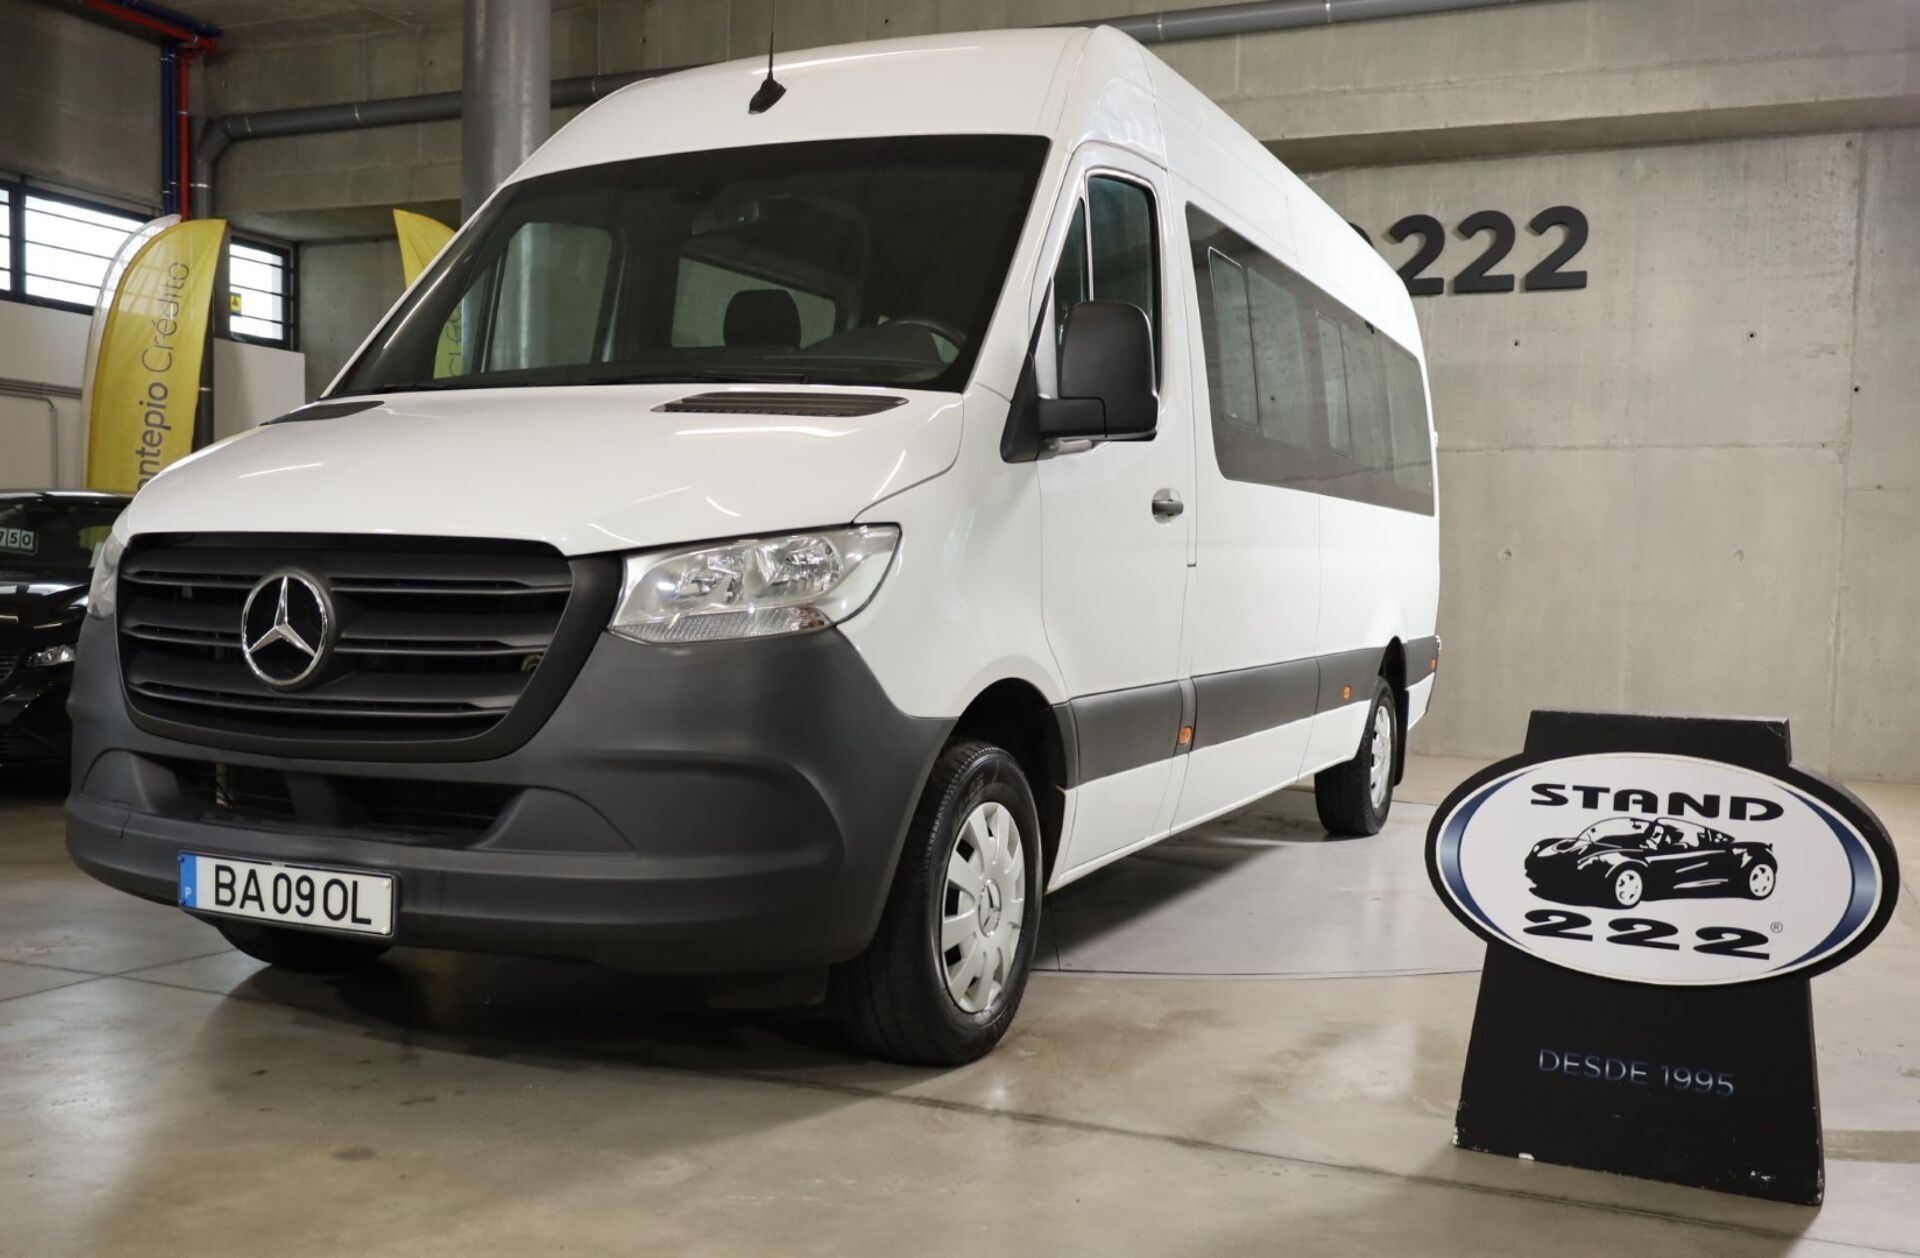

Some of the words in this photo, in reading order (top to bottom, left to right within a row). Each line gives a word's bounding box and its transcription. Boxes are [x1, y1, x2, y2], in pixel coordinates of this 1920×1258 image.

[141, 261, 190, 373] Crédito
[1530, 783, 1784, 821] STAND
[184, 886, 193, 899] P
[1522, 908, 1770, 960] 222
[1538, 1049, 1650, 1085] DESDE
[1661, 1065, 1735, 1096] 1995
